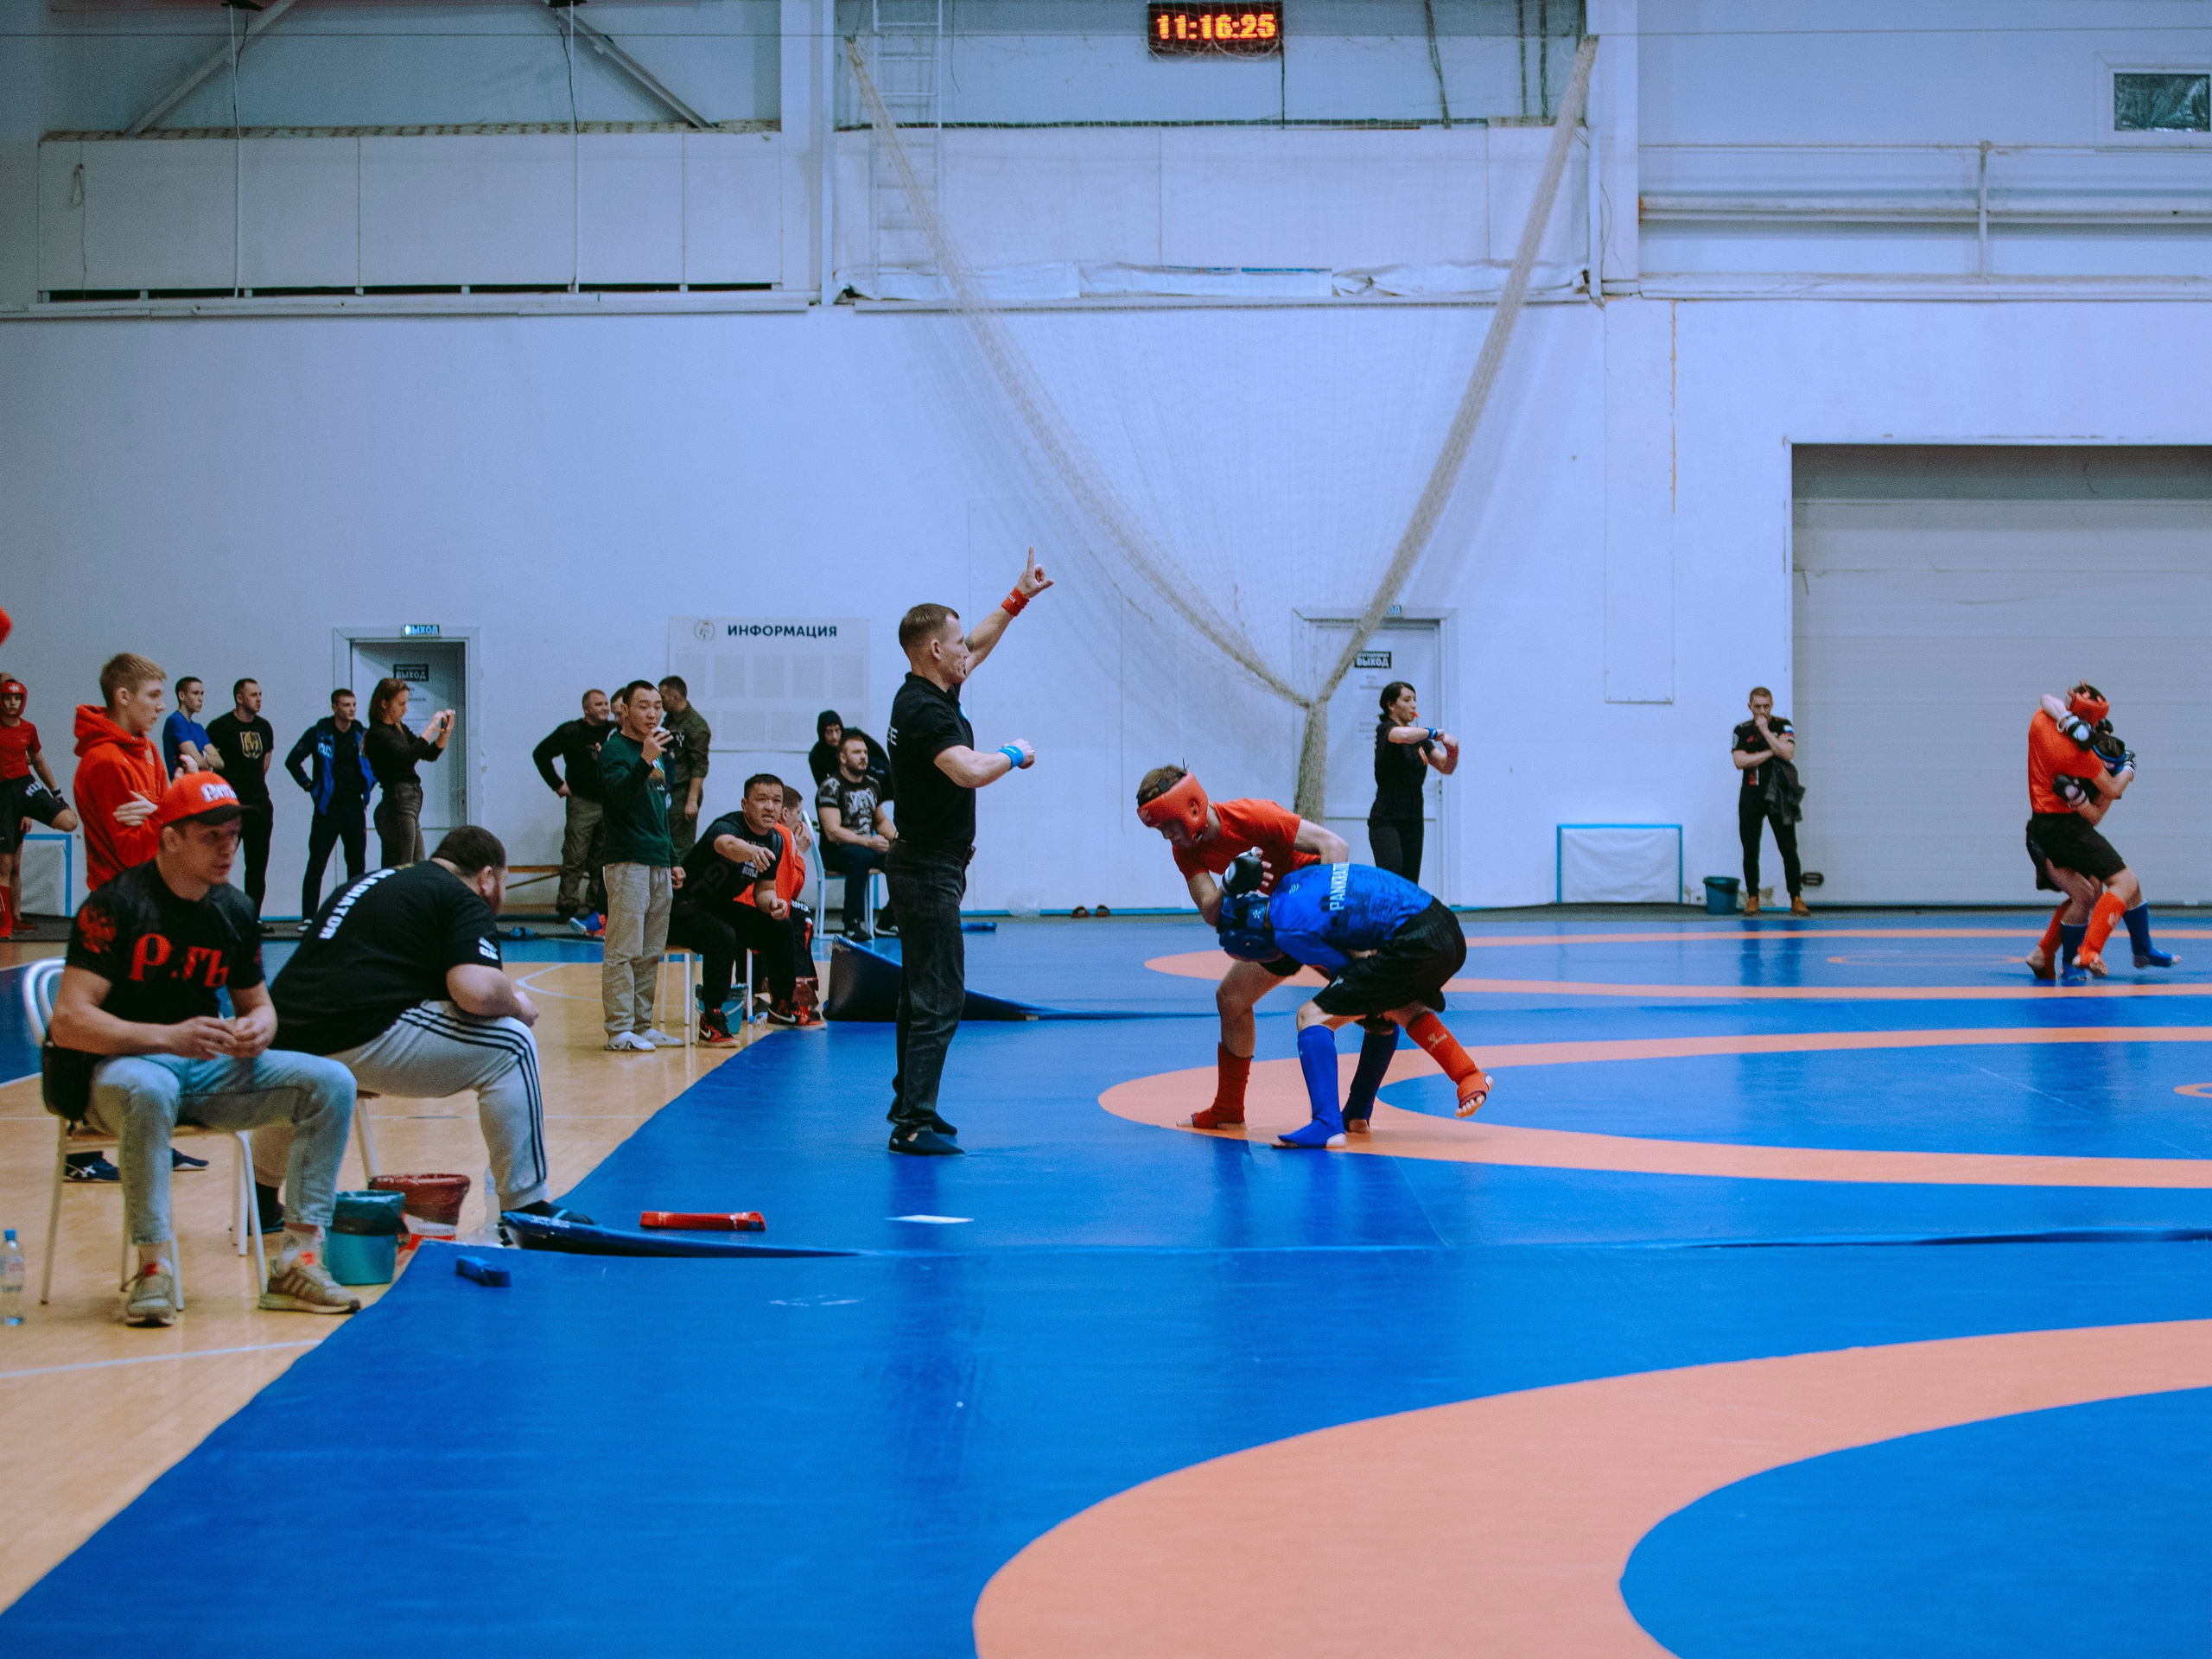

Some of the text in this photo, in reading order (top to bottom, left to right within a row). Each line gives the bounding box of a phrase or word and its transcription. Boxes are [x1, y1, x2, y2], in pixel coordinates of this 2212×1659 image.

[1157, 14, 1276, 40] 11:16:25
[728, 625, 837, 638] ИНФОРМАЦИЯ
[1357, 658, 1389, 667] ВЫХОД
